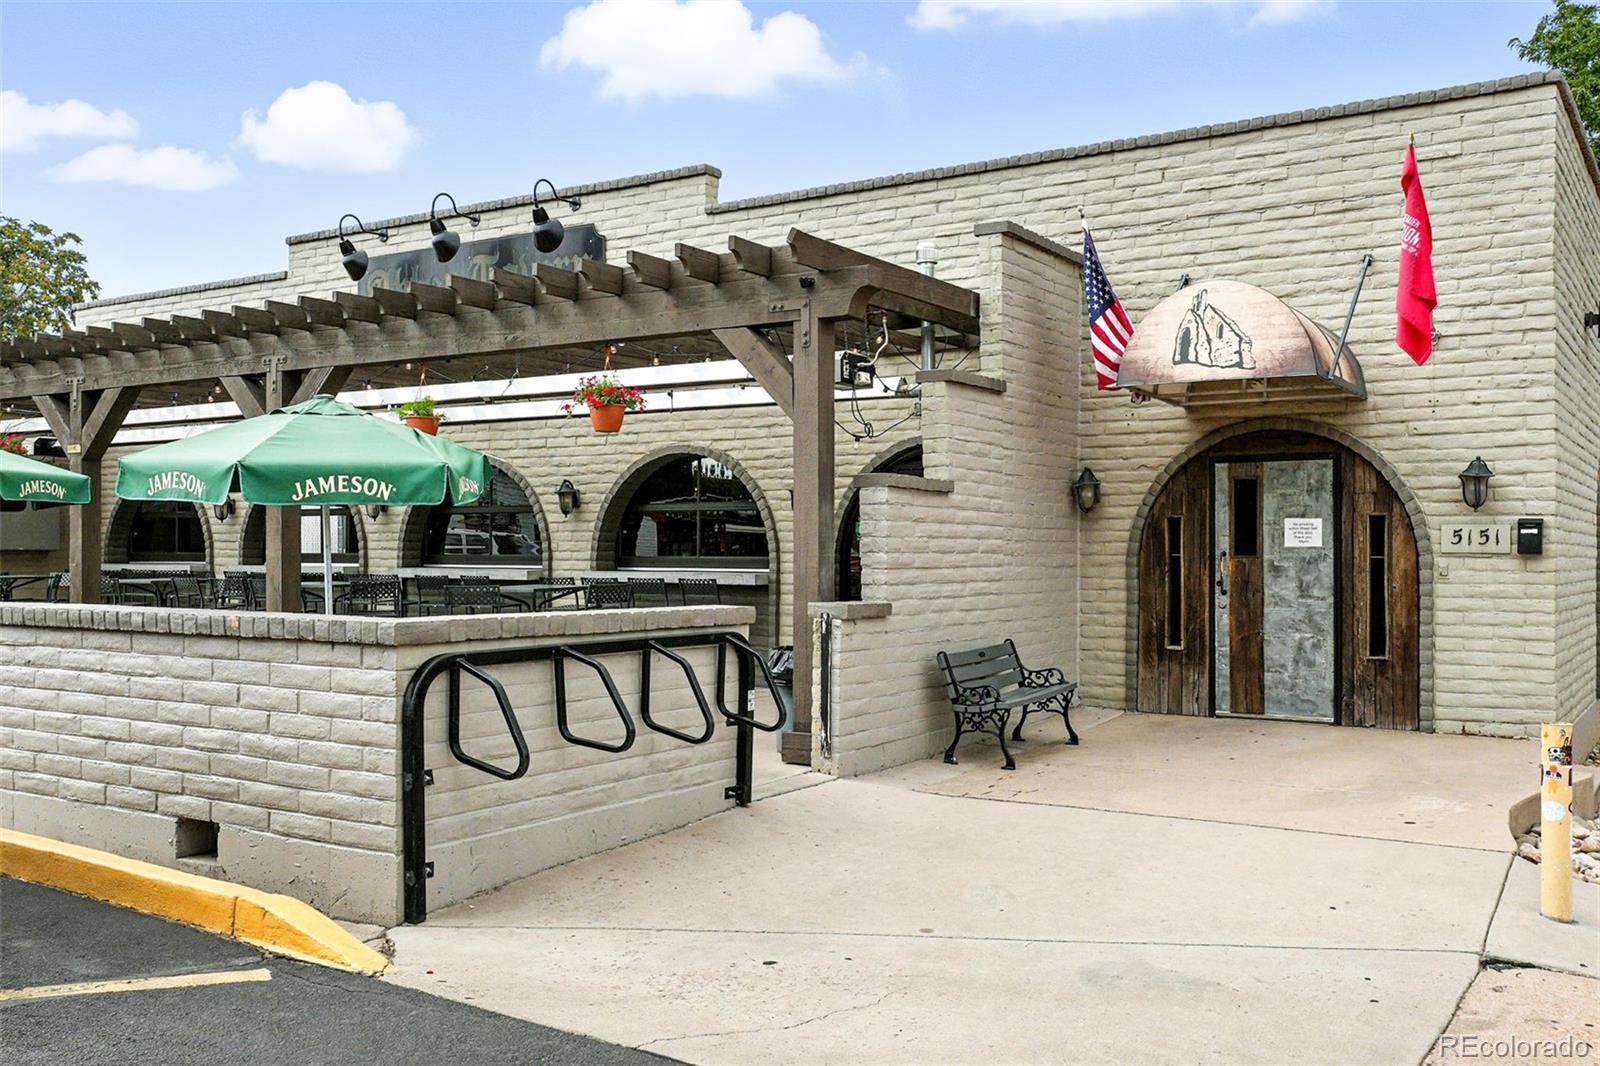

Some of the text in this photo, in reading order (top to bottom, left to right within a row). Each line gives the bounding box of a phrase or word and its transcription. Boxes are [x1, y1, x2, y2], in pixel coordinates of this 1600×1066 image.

[19, 480, 65, 499] JAMESON
[147, 471, 205, 497] JAMESON
[291, 475, 394, 501] JAMESON
[1450, 528, 1499, 546] 5151
